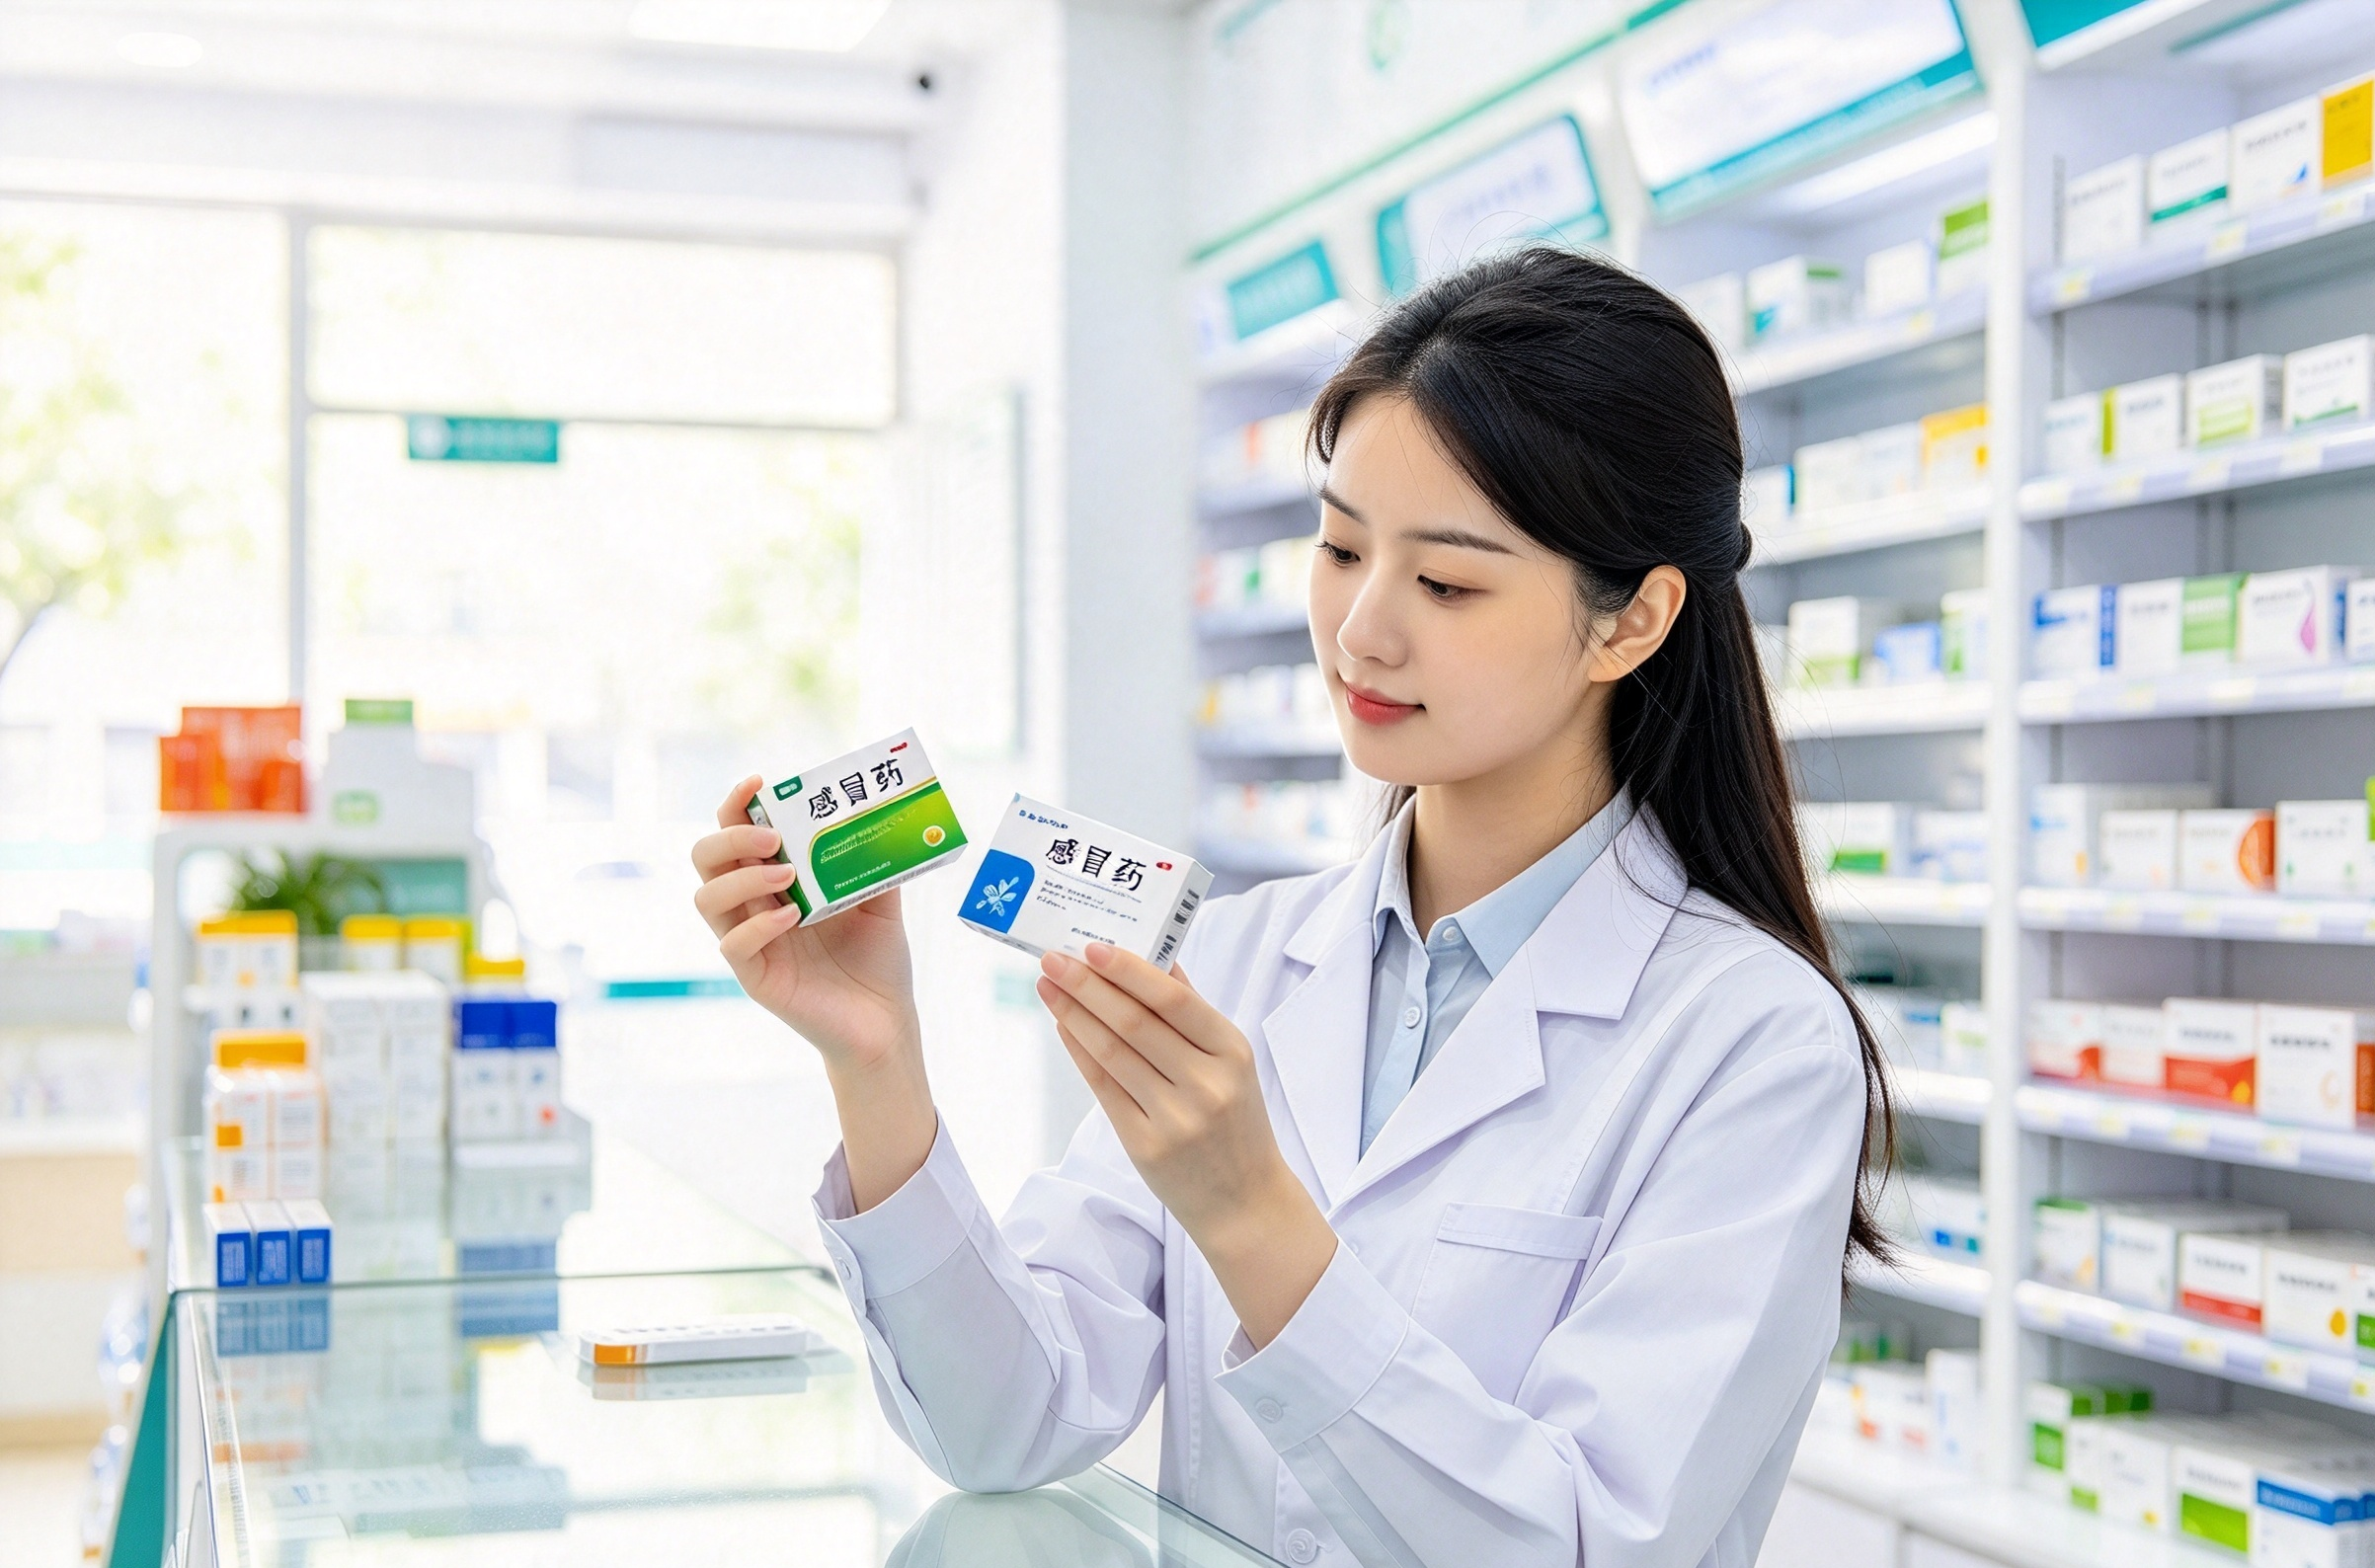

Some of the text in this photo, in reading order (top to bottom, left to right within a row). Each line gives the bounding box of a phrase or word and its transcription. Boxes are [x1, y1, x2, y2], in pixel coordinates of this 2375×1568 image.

[808, 758, 905, 821] 感冒药
[1045, 838, 1148, 892] 感冒药
